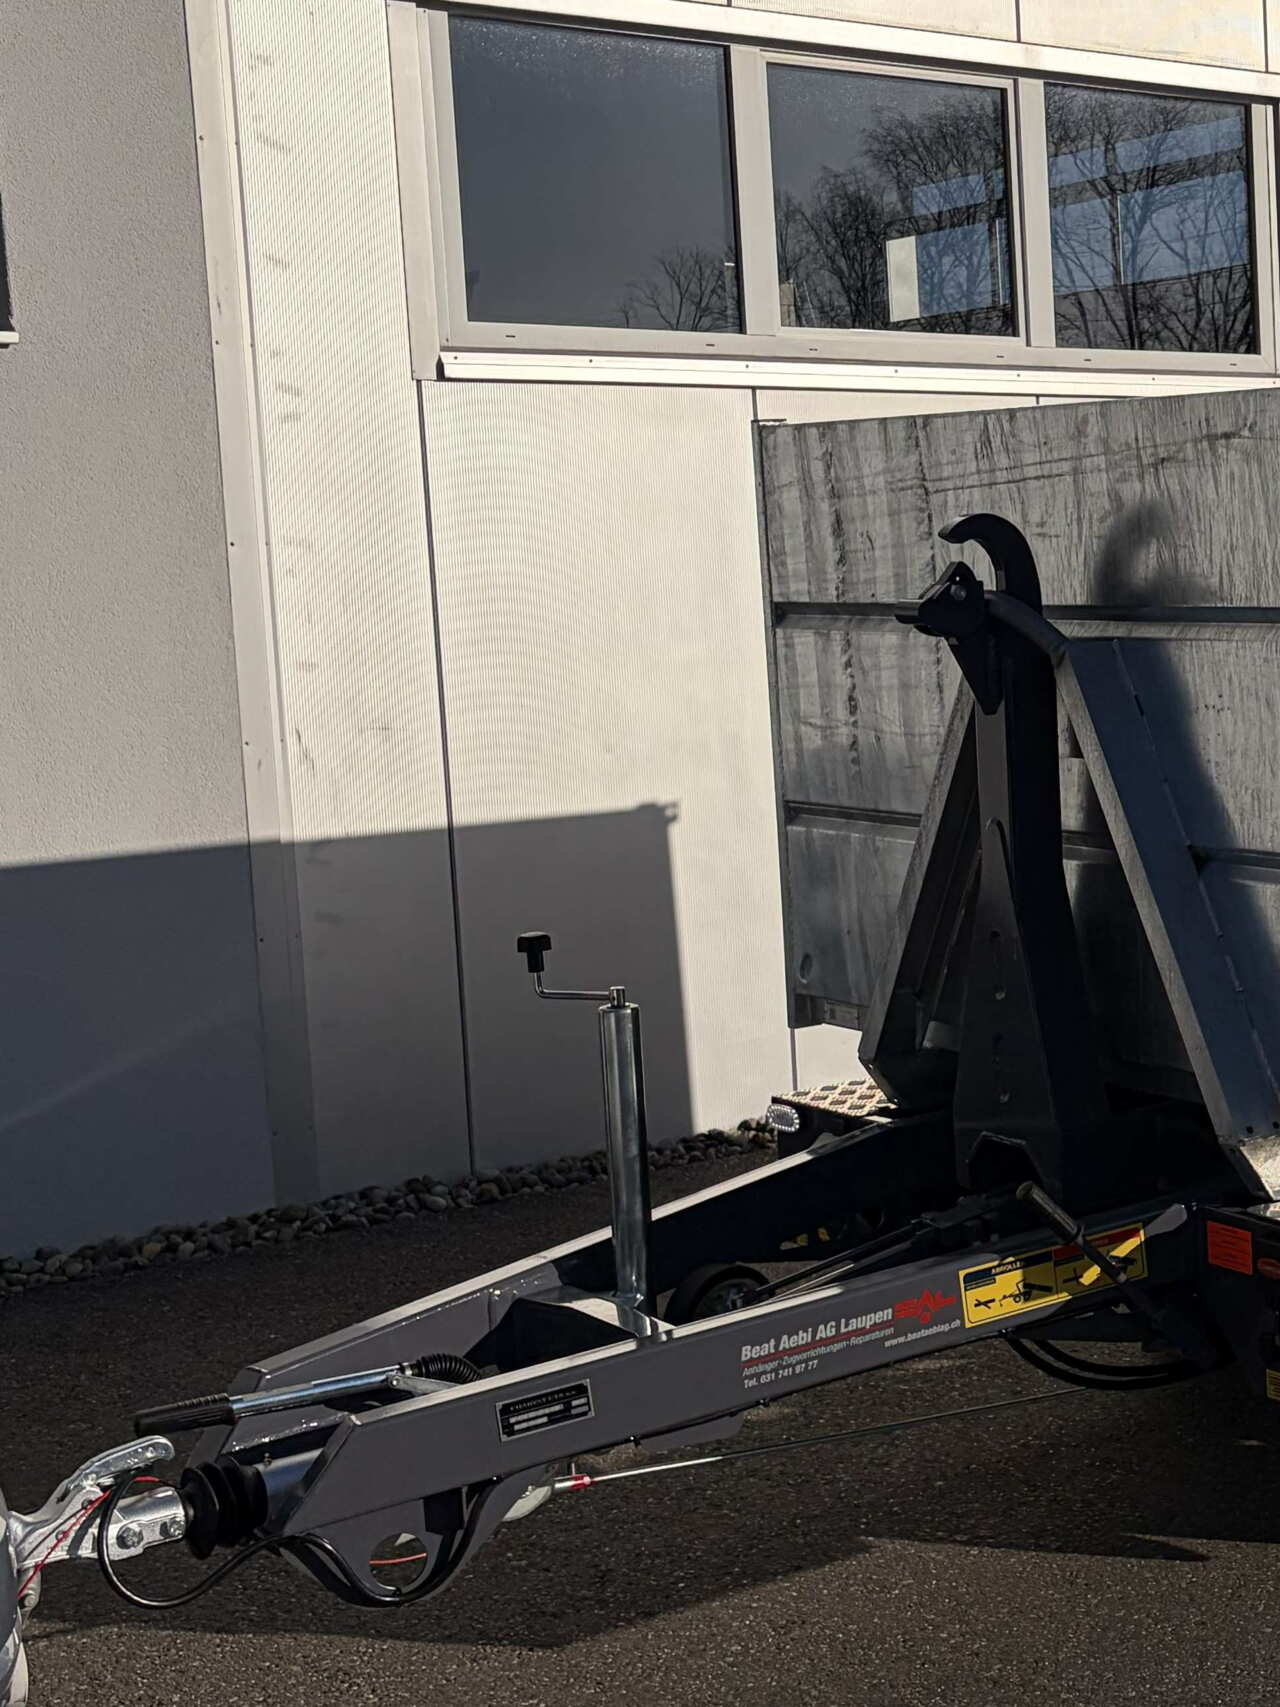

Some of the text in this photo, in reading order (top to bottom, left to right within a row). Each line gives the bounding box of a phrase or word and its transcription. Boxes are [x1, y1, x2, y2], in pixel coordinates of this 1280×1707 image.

[741, 1307, 893, 1362] Beat Aebi AG Laupen
[743, 1376, 758, 1389] Tel.
[760, 1372, 776, 1385] 031
[778, 1367, 793, 1380] 741
